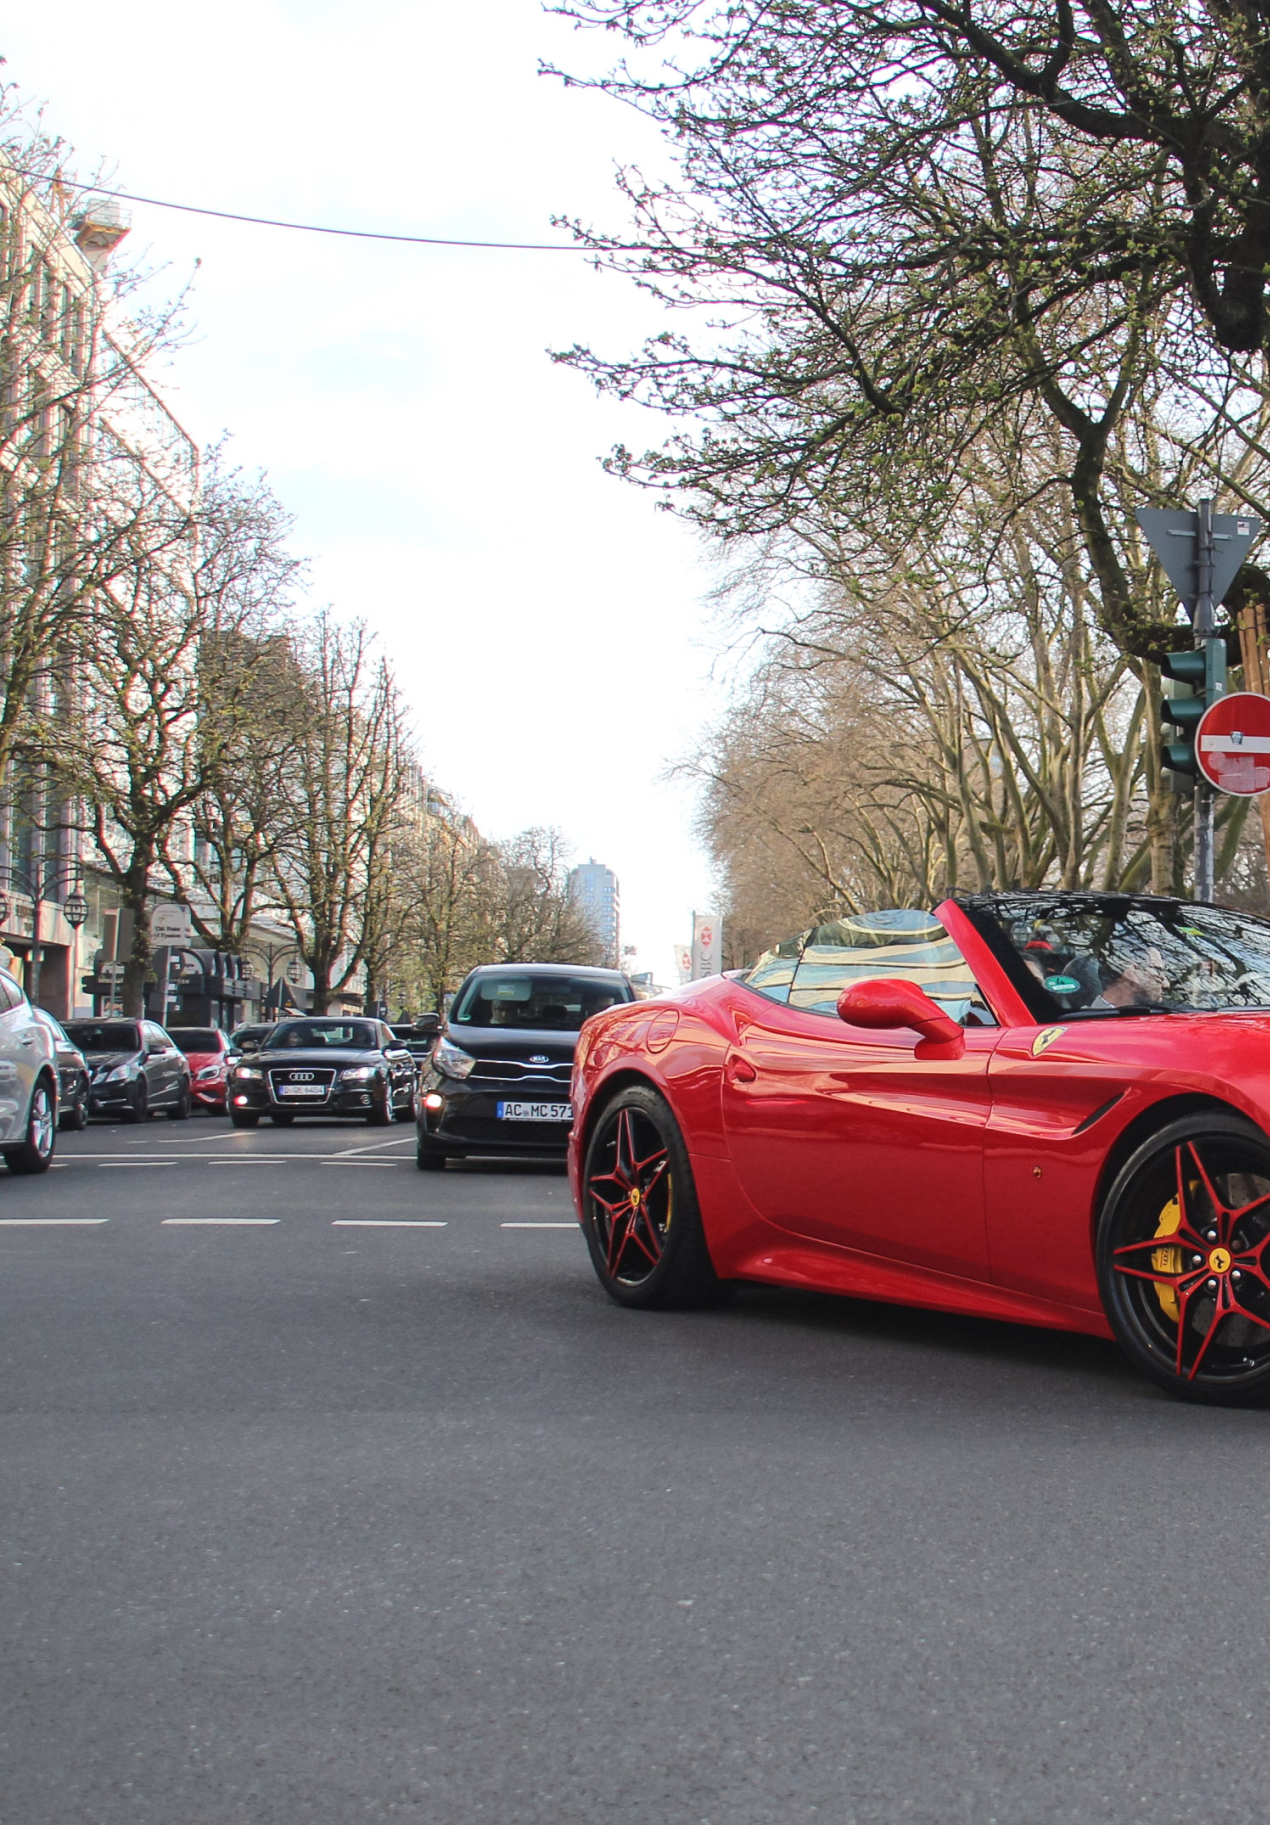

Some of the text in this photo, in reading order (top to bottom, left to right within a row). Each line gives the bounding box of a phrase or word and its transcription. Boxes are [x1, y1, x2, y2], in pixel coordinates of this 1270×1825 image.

[700, 951, 712, 978] SBC
[505, 1104, 522, 1116] AC
[531, 1105, 548, 1117] MC
